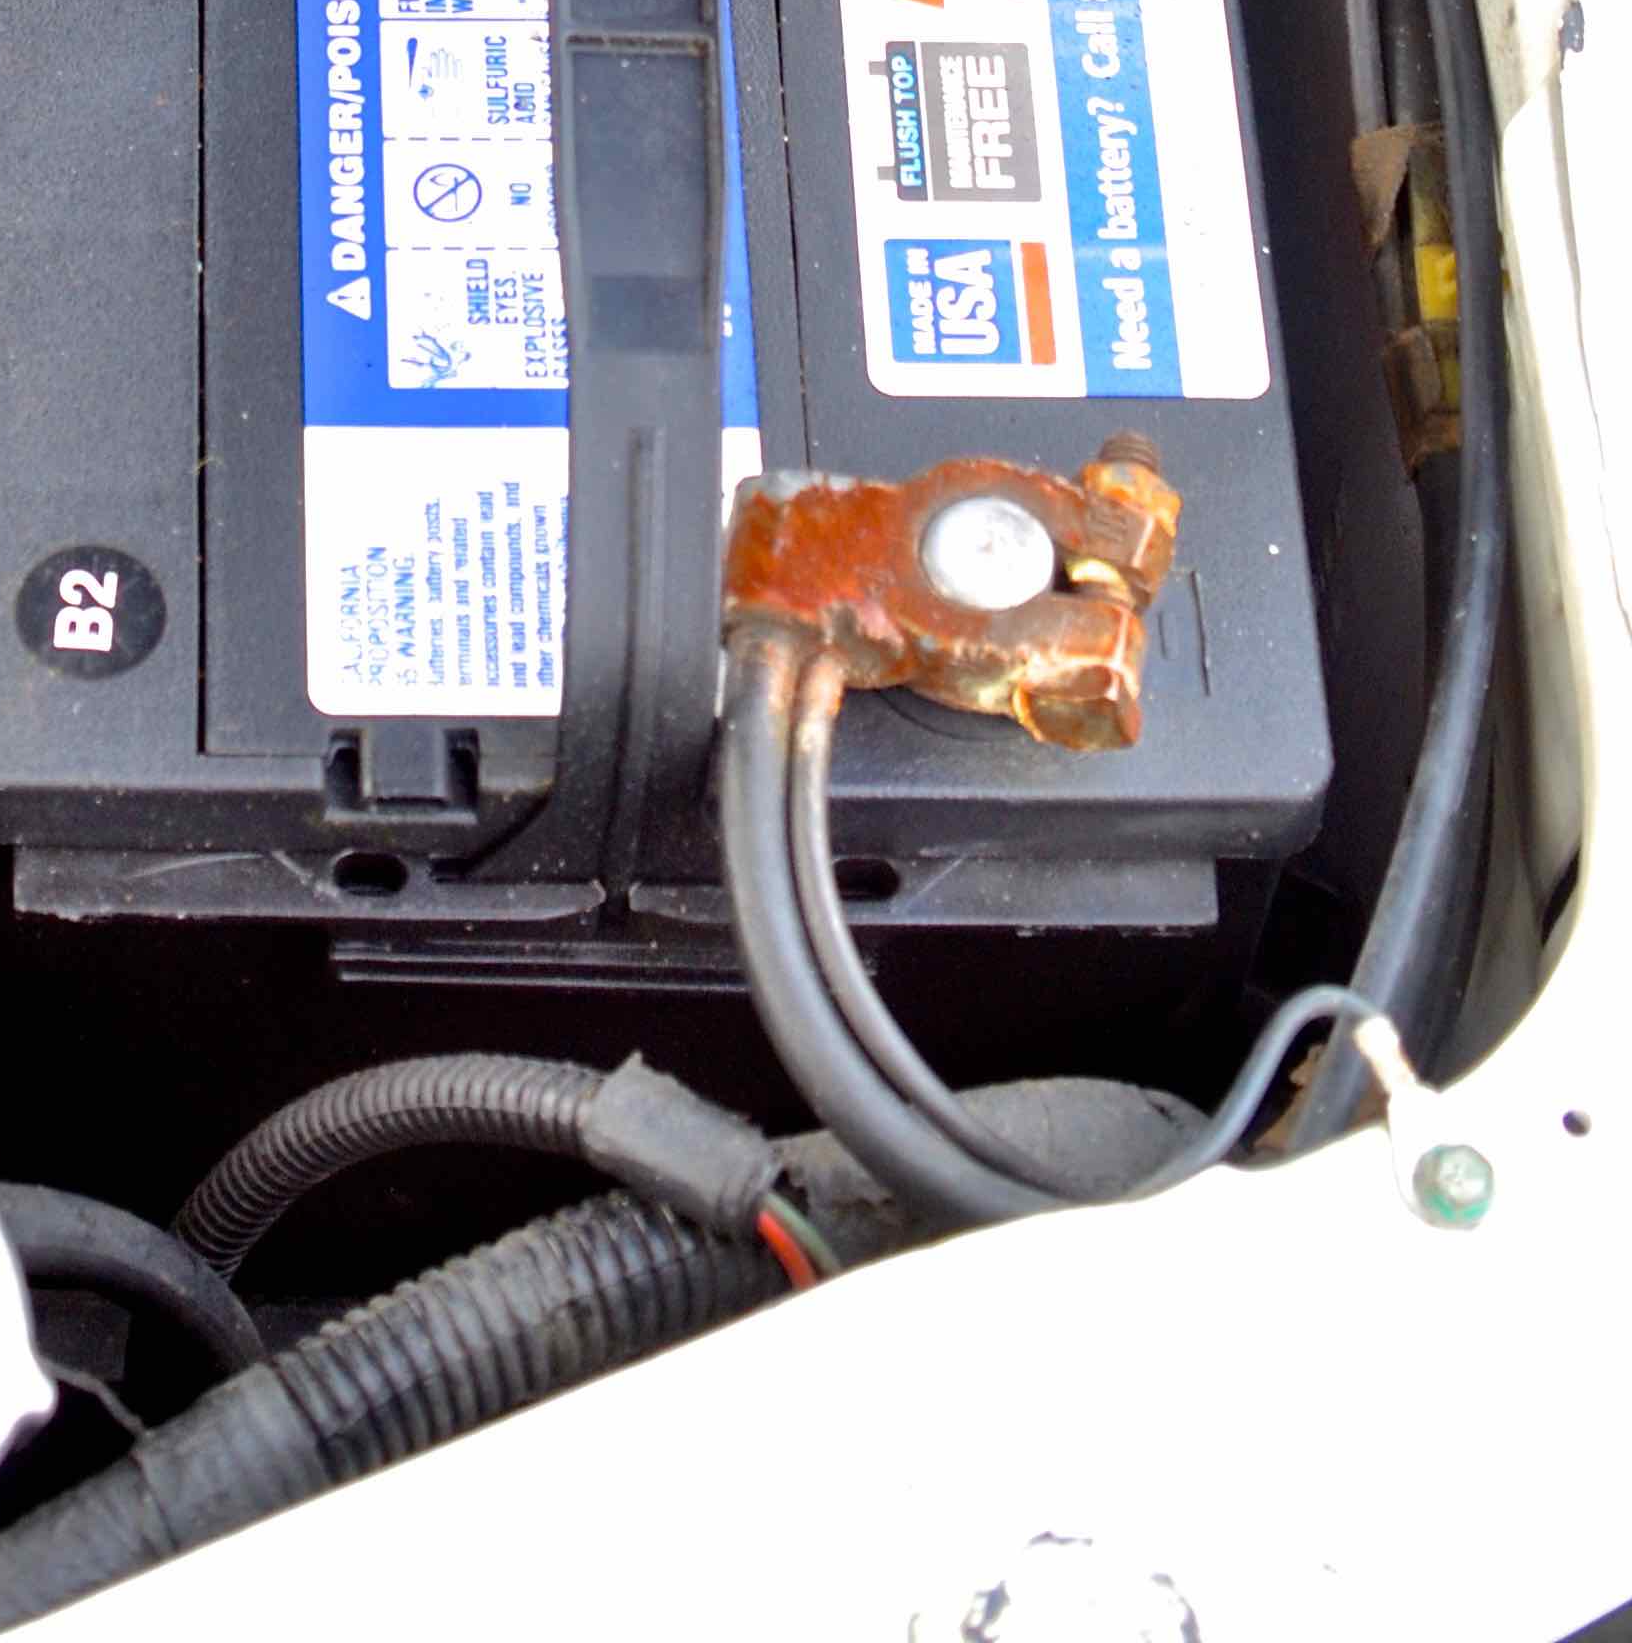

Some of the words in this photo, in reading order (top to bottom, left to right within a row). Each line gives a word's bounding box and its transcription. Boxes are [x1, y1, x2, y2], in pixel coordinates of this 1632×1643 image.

[485, 35, 511, 126] SULFURIC
[890, 55, 917, 102] TOP
[1074, 9, 1121, 80] Call
[514, 81, 537, 125] ACID
[939, 53, 974, 189] MAINTENANCE
[965, 53, 1017, 191] FREE
[896, 112, 923, 187] FLUSH
[1085, 95, 1139, 241] battery?
[510, 181, 532, 207] NO
[466, 258, 491, 326] SHIELD
[905, 247, 931, 275] IN
[1111, 247, 1142, 272] a
[523, 271, 548, 379] EXPLOSIVE
[909, 280, 937, 356] MADE
[933, 248, 1001, 357] USA
[1102, 275, 1154, 372] Need
[53, 568, 119, 652] B2
